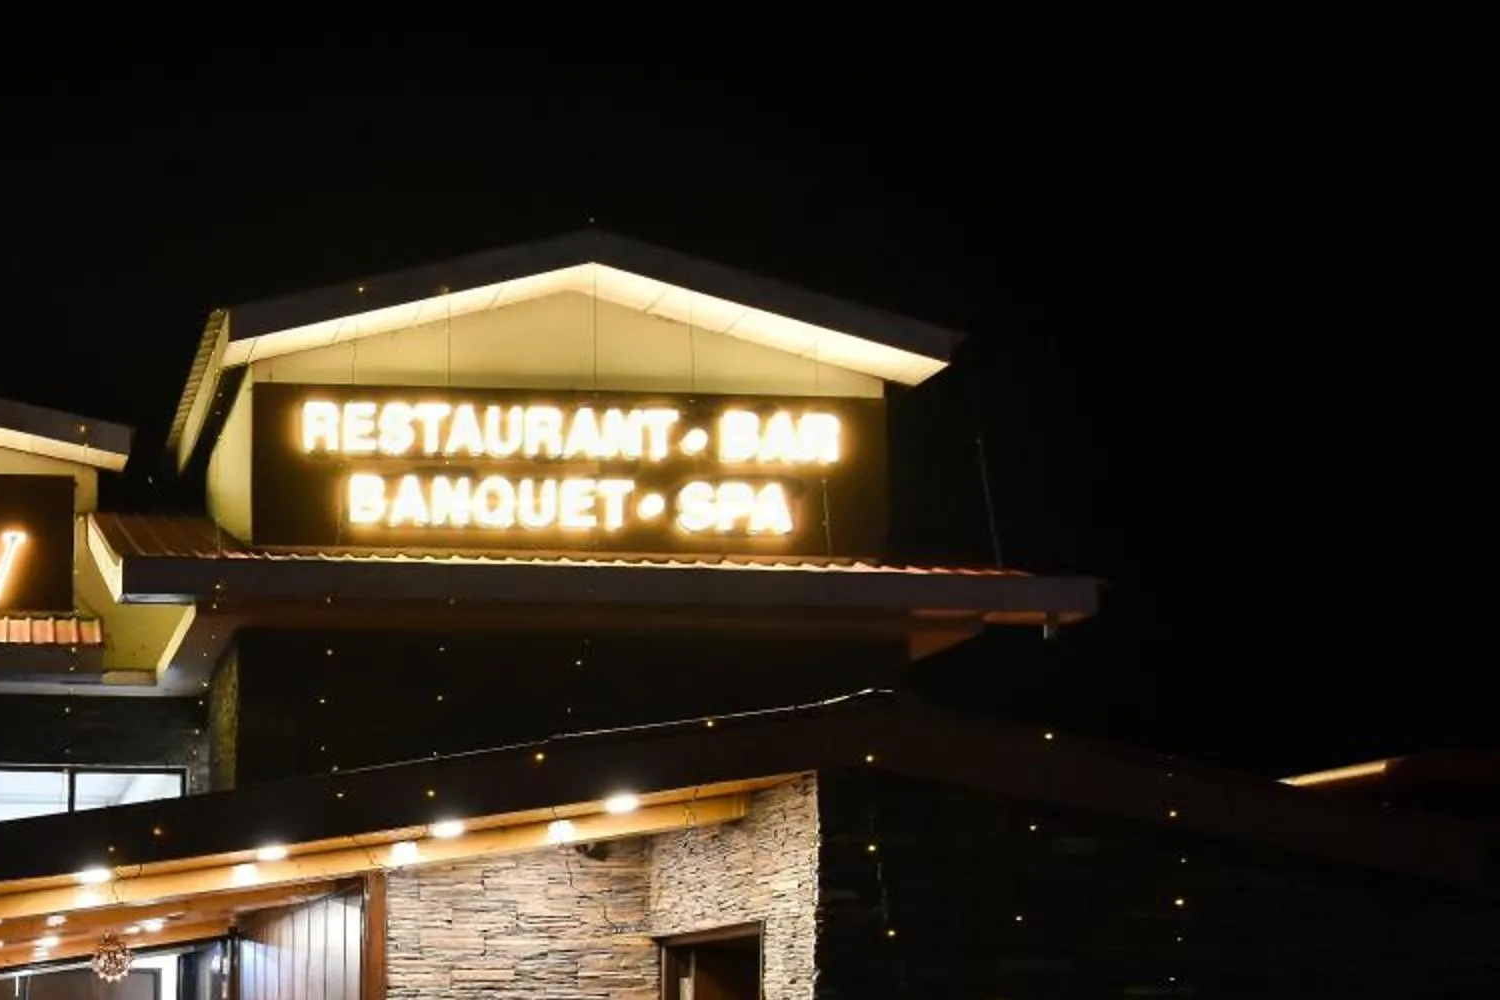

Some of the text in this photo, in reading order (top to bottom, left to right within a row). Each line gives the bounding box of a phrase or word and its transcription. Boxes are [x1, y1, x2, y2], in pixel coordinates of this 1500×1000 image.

[299, 400, 843, 465] RESTAURANT BAR
[347, 473, 794, 536] BANQUET SPA
